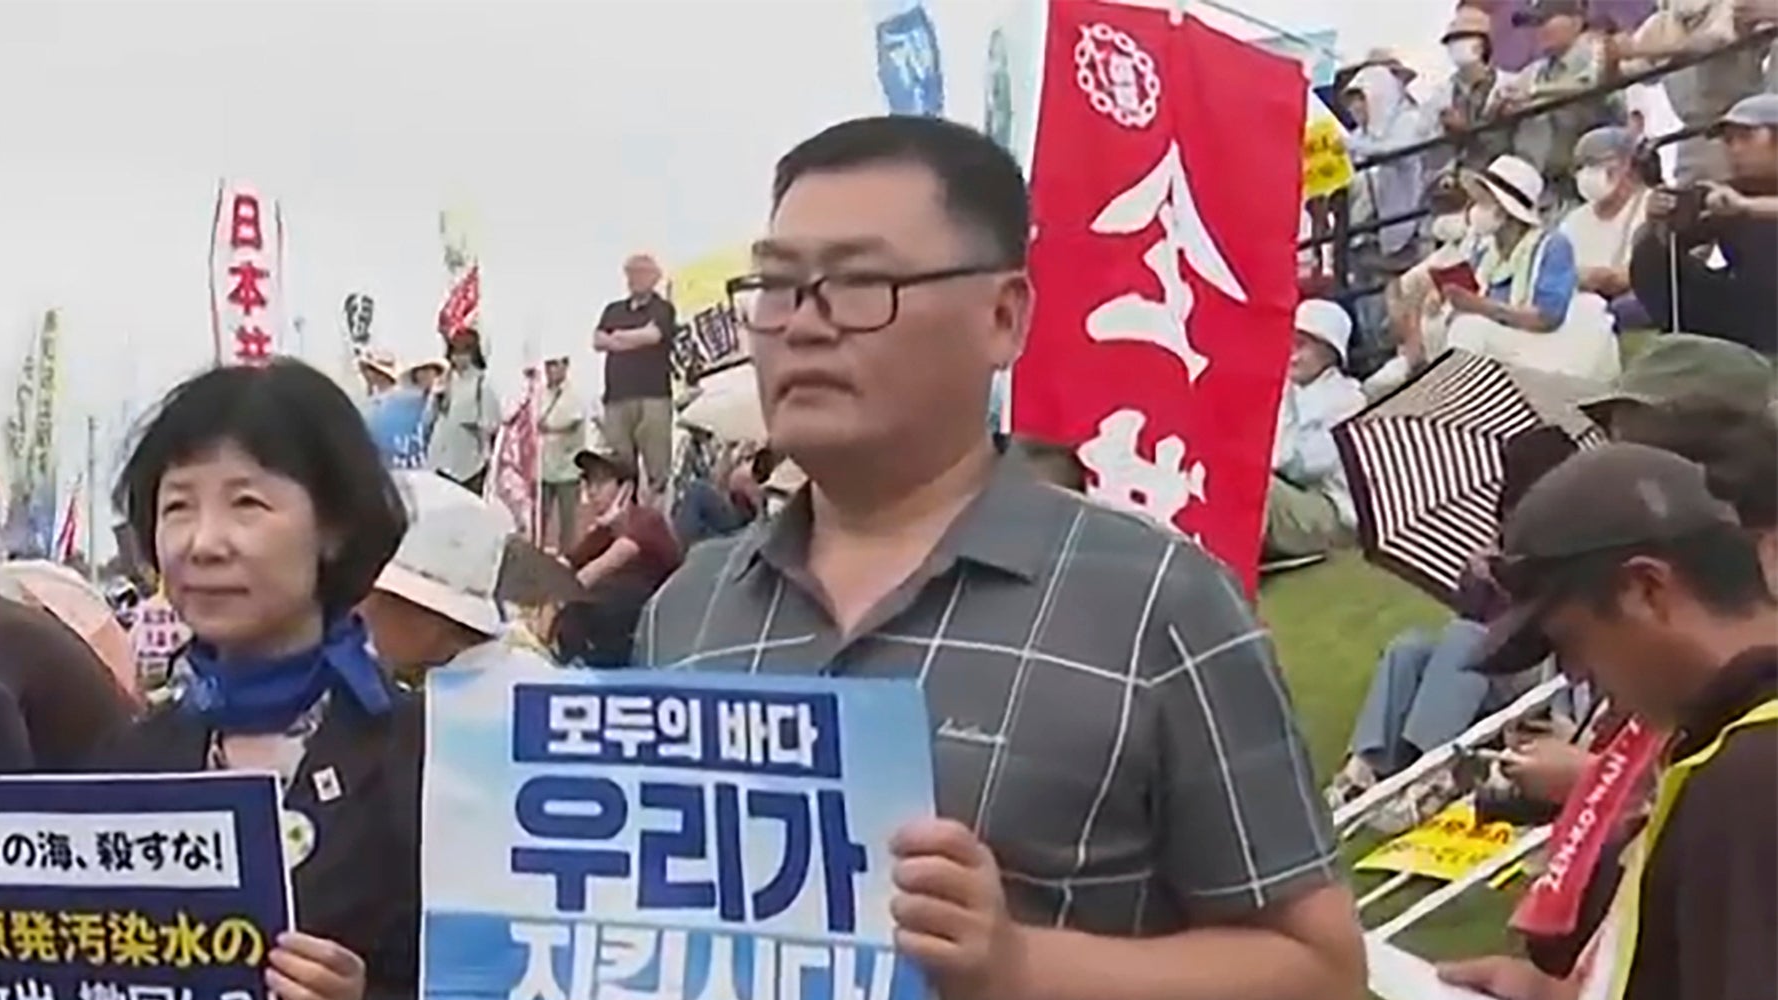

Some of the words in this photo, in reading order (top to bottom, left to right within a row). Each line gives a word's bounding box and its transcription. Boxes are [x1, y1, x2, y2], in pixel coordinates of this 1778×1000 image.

[547, 693, 703, 760] 모두의
[718, 699, 819, 768] 바다
[510, 774, 869, 934] 우리가
